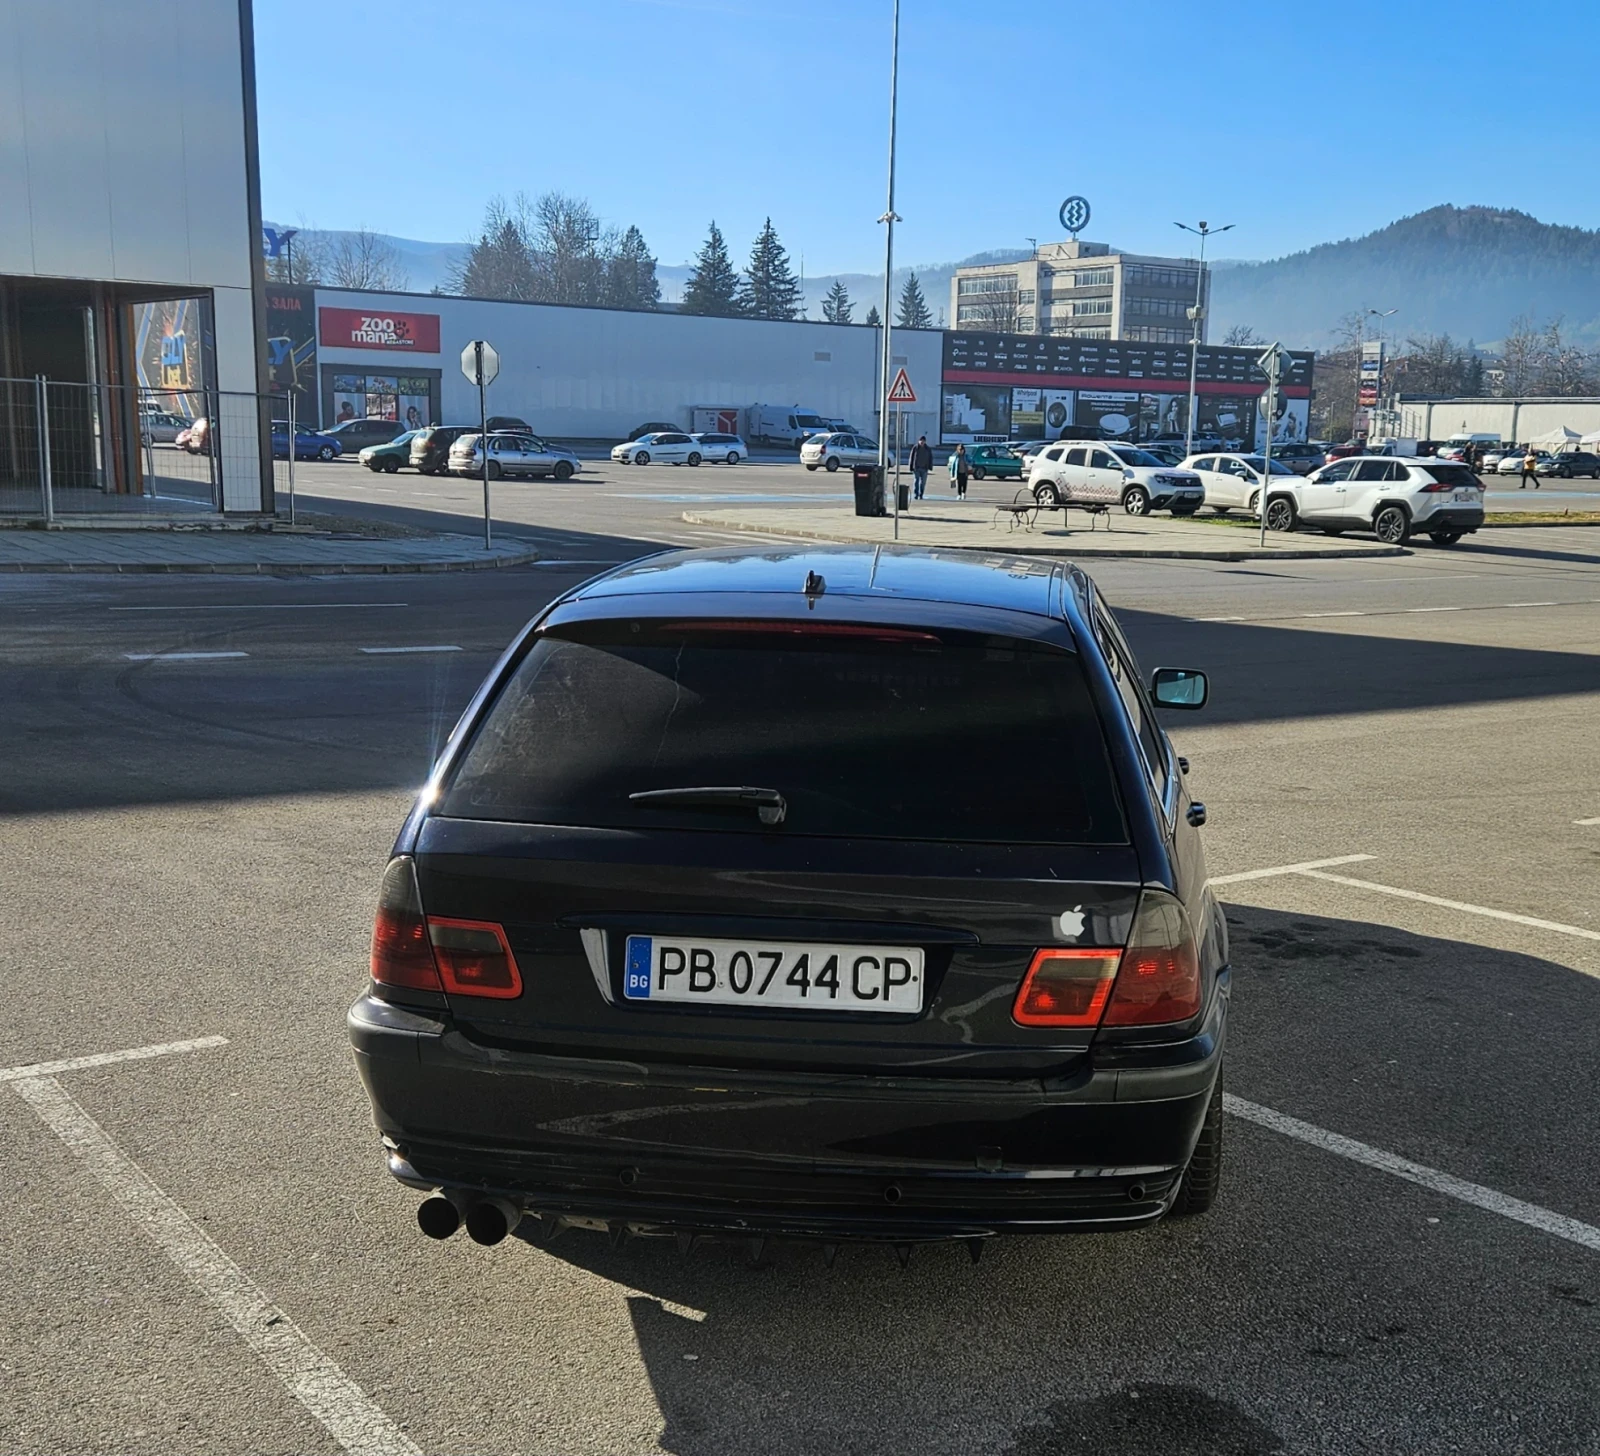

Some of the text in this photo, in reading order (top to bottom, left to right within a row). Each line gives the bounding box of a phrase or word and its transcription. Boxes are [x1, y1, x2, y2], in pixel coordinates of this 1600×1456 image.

[272, 297, 302, 311] ЗАЛА
[351, 330, 397, 344] mania
[1016, 389, 1038, 397] Whirlpool
[973, 435, 1008, 443] LIEBHERR
[658, 946, 913, 1002] PB 0744 CP
[629, 974, 649, 989] BG
